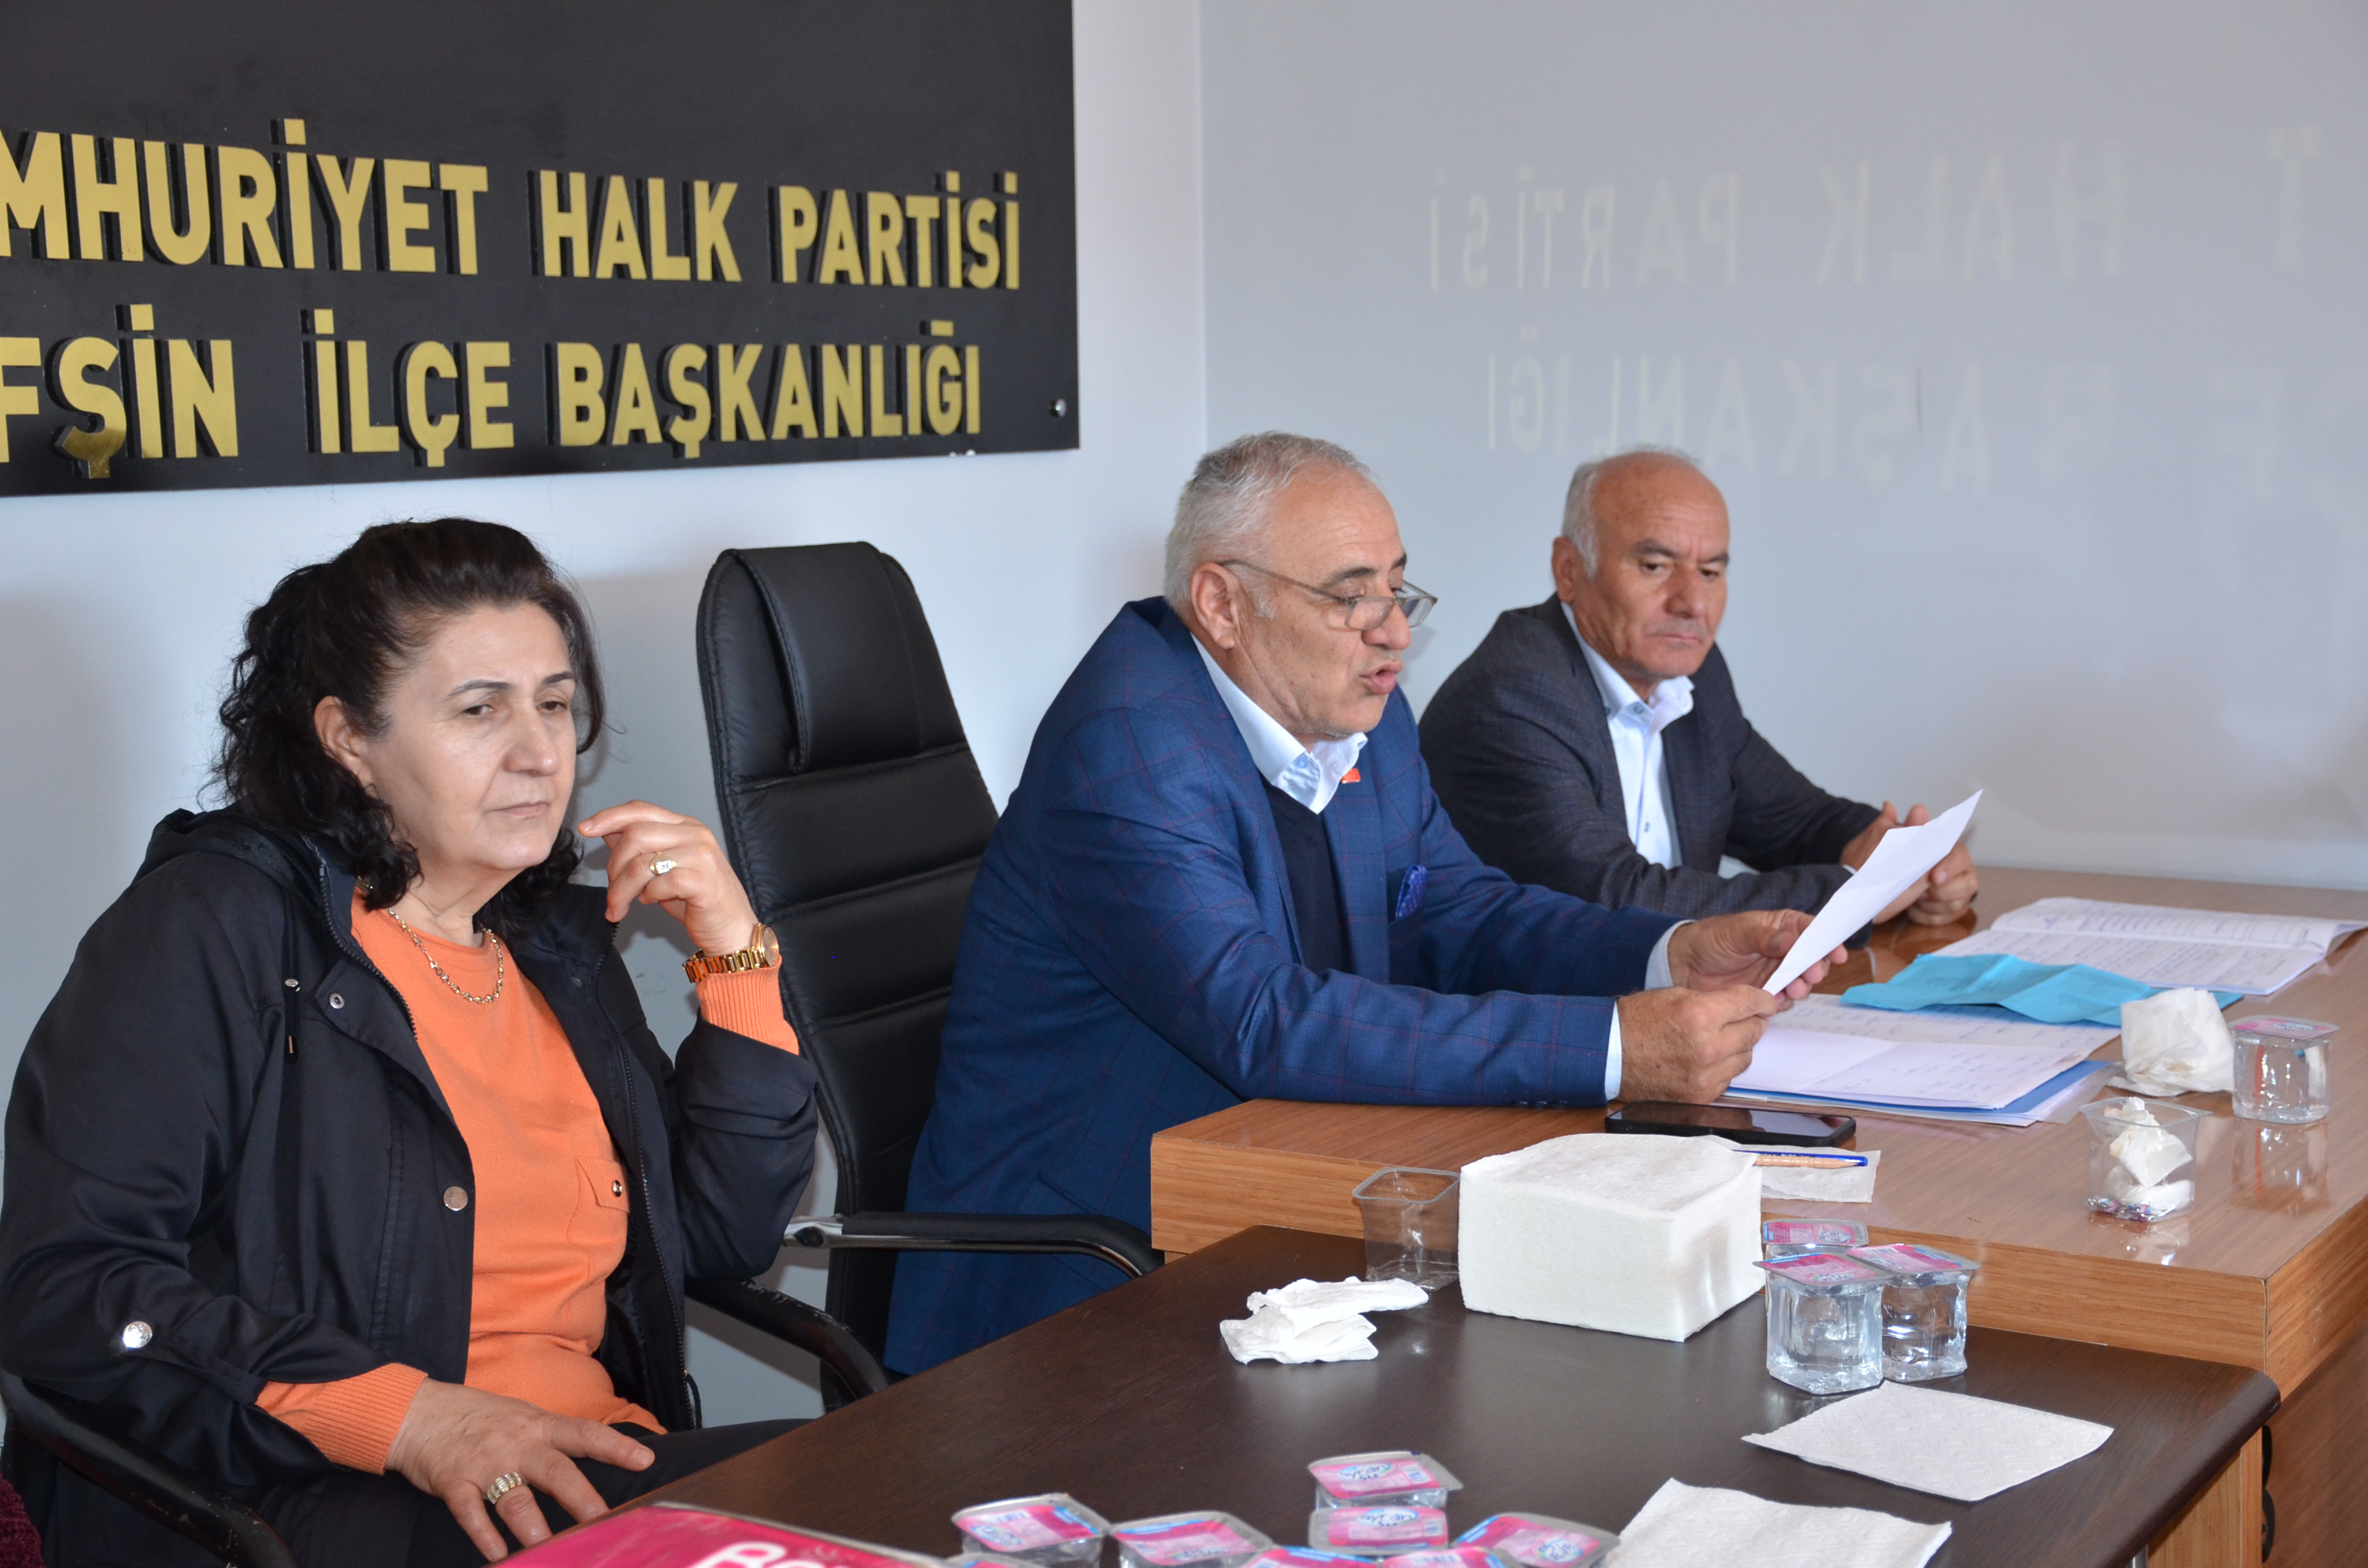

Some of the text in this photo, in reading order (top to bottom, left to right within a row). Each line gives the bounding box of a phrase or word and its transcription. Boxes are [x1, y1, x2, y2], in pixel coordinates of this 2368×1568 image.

[0, 118, 1020, 290] MHURİYET HALK PARTİSİ
[315, 308, 514, 468] İLÇE
[557, 320, 981, 459] BAŞKANLIĞI
